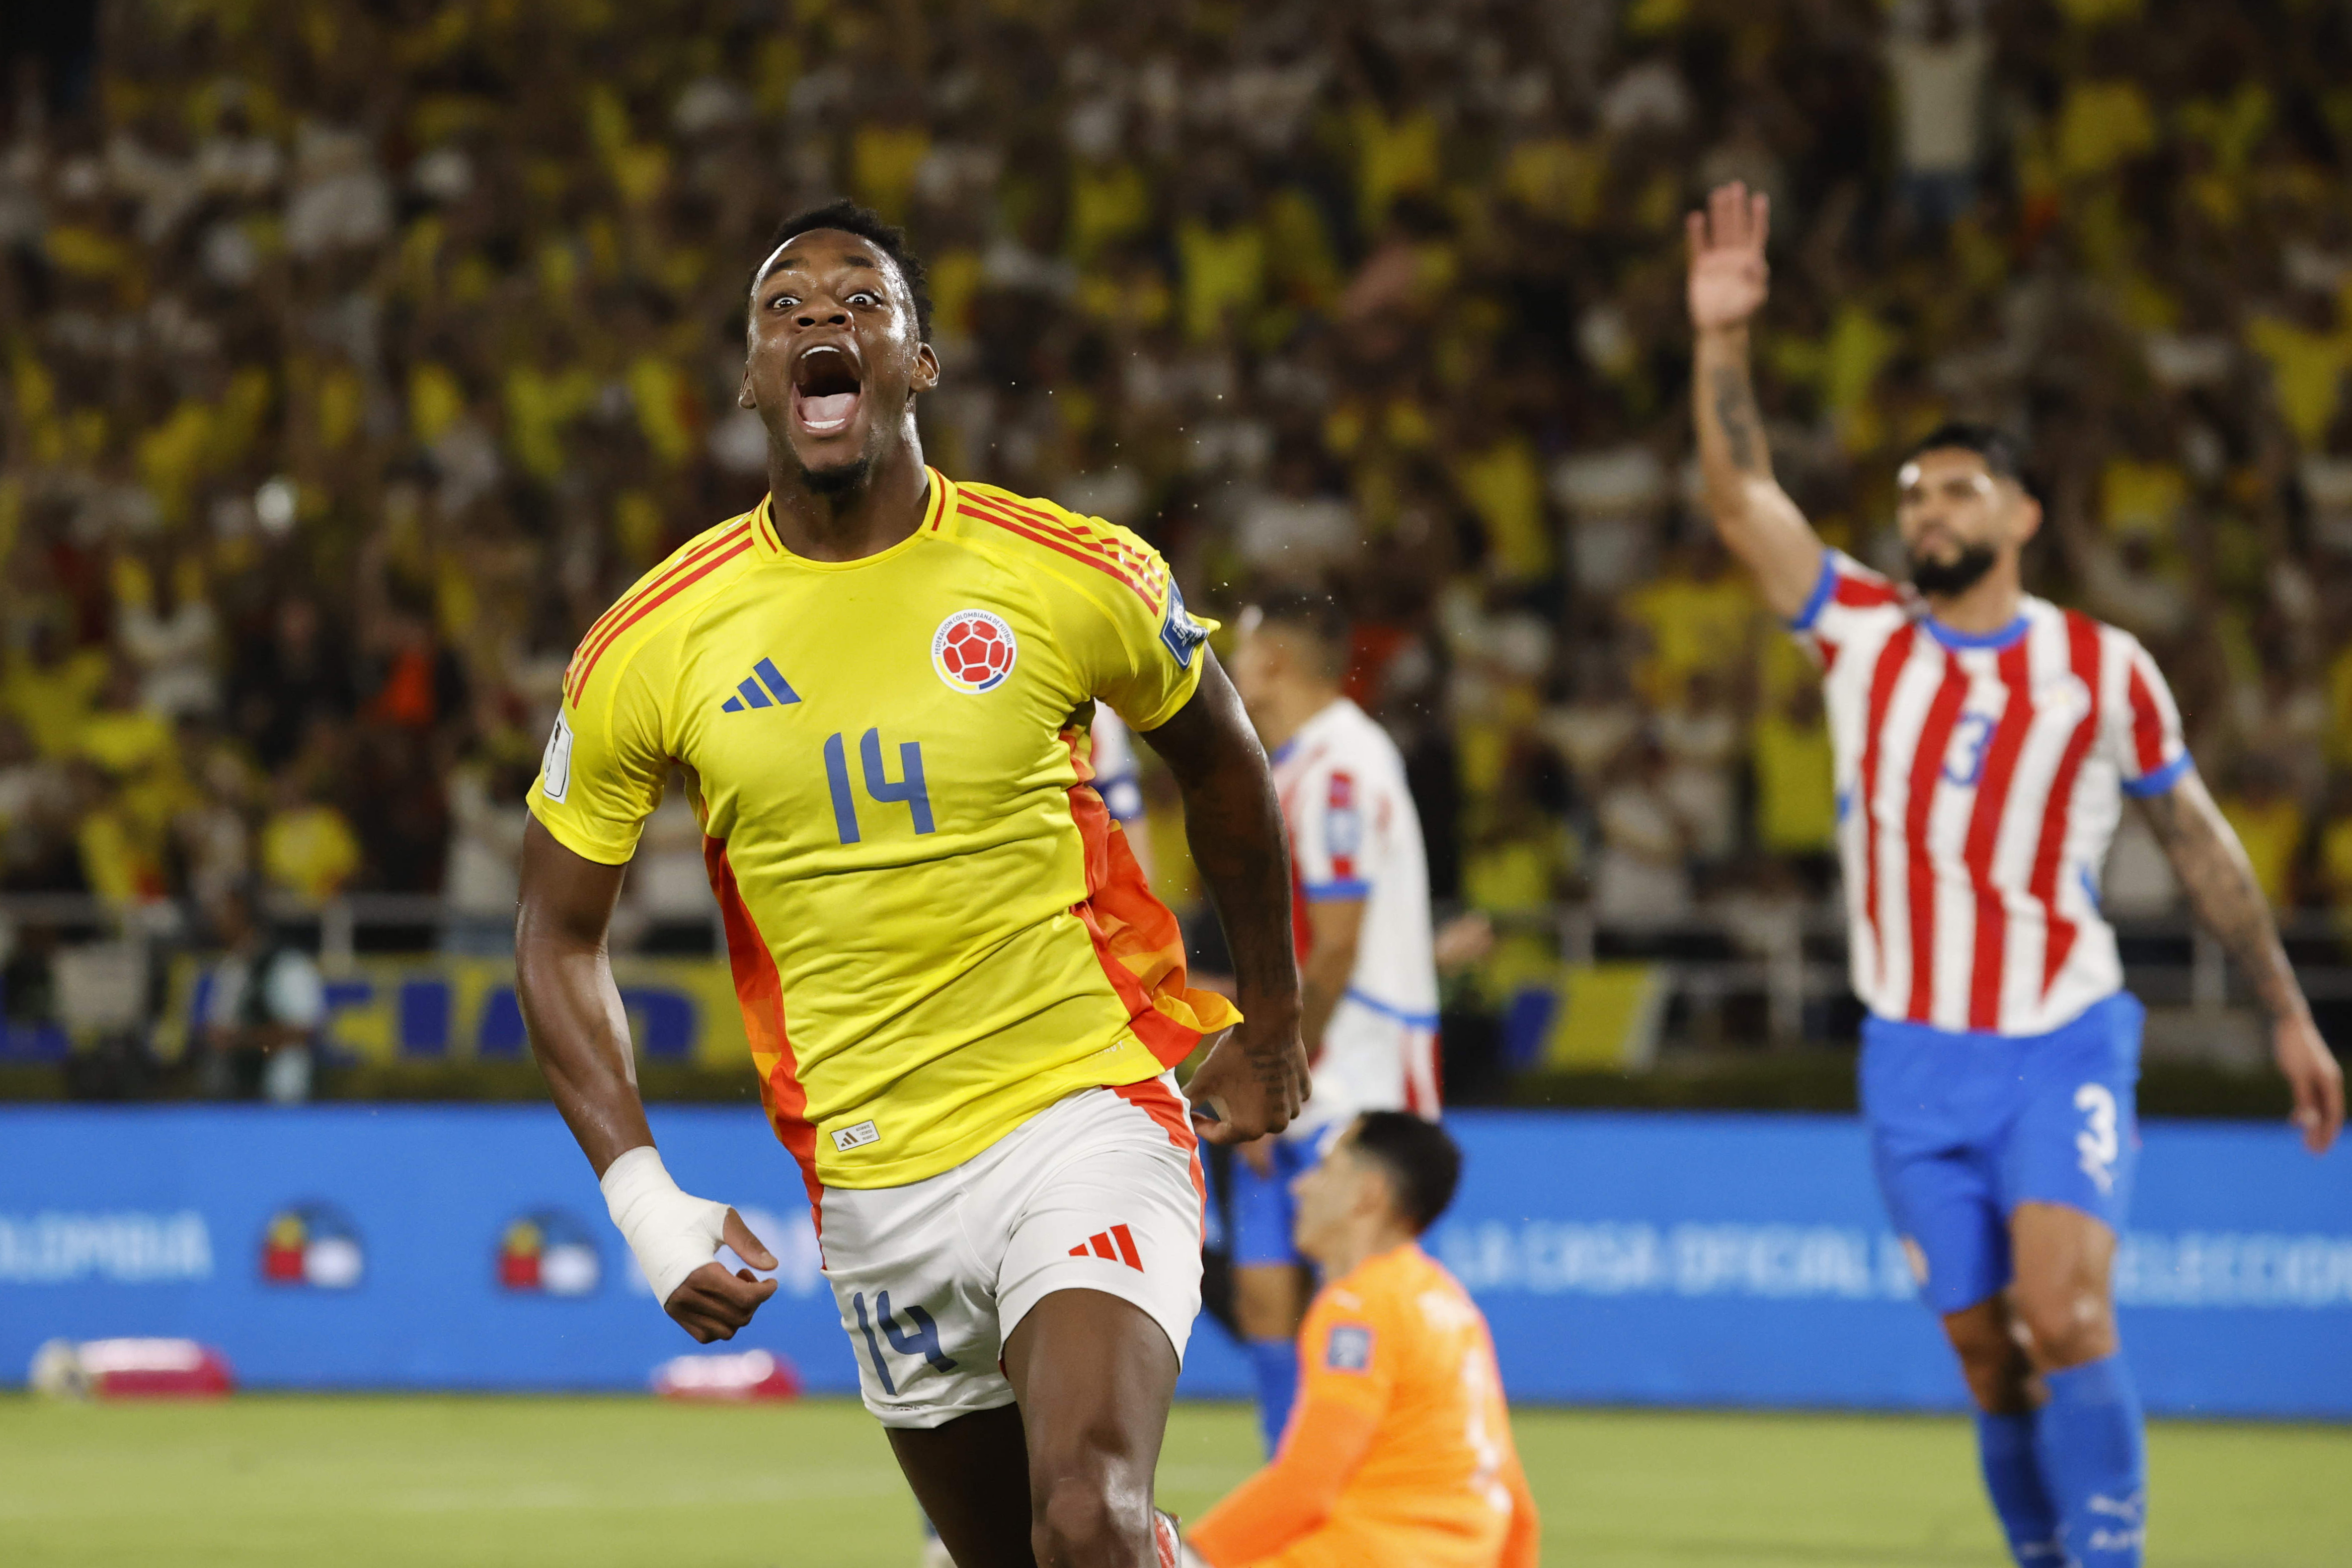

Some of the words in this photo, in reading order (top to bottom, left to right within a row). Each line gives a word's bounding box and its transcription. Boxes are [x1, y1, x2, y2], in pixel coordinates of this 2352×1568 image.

[934, 619, 954, 655] FEDERACION
[953, 612, 992, 622] COLOMBIANA
[998, 624, 1013, 646] FUTBOL
[823, 727, 935, 844] 14
[1941, 712, 1998, 789] 3
[2074, 1082, 2119, 1165] 3
[853, 1290, 958, 1396] 14
